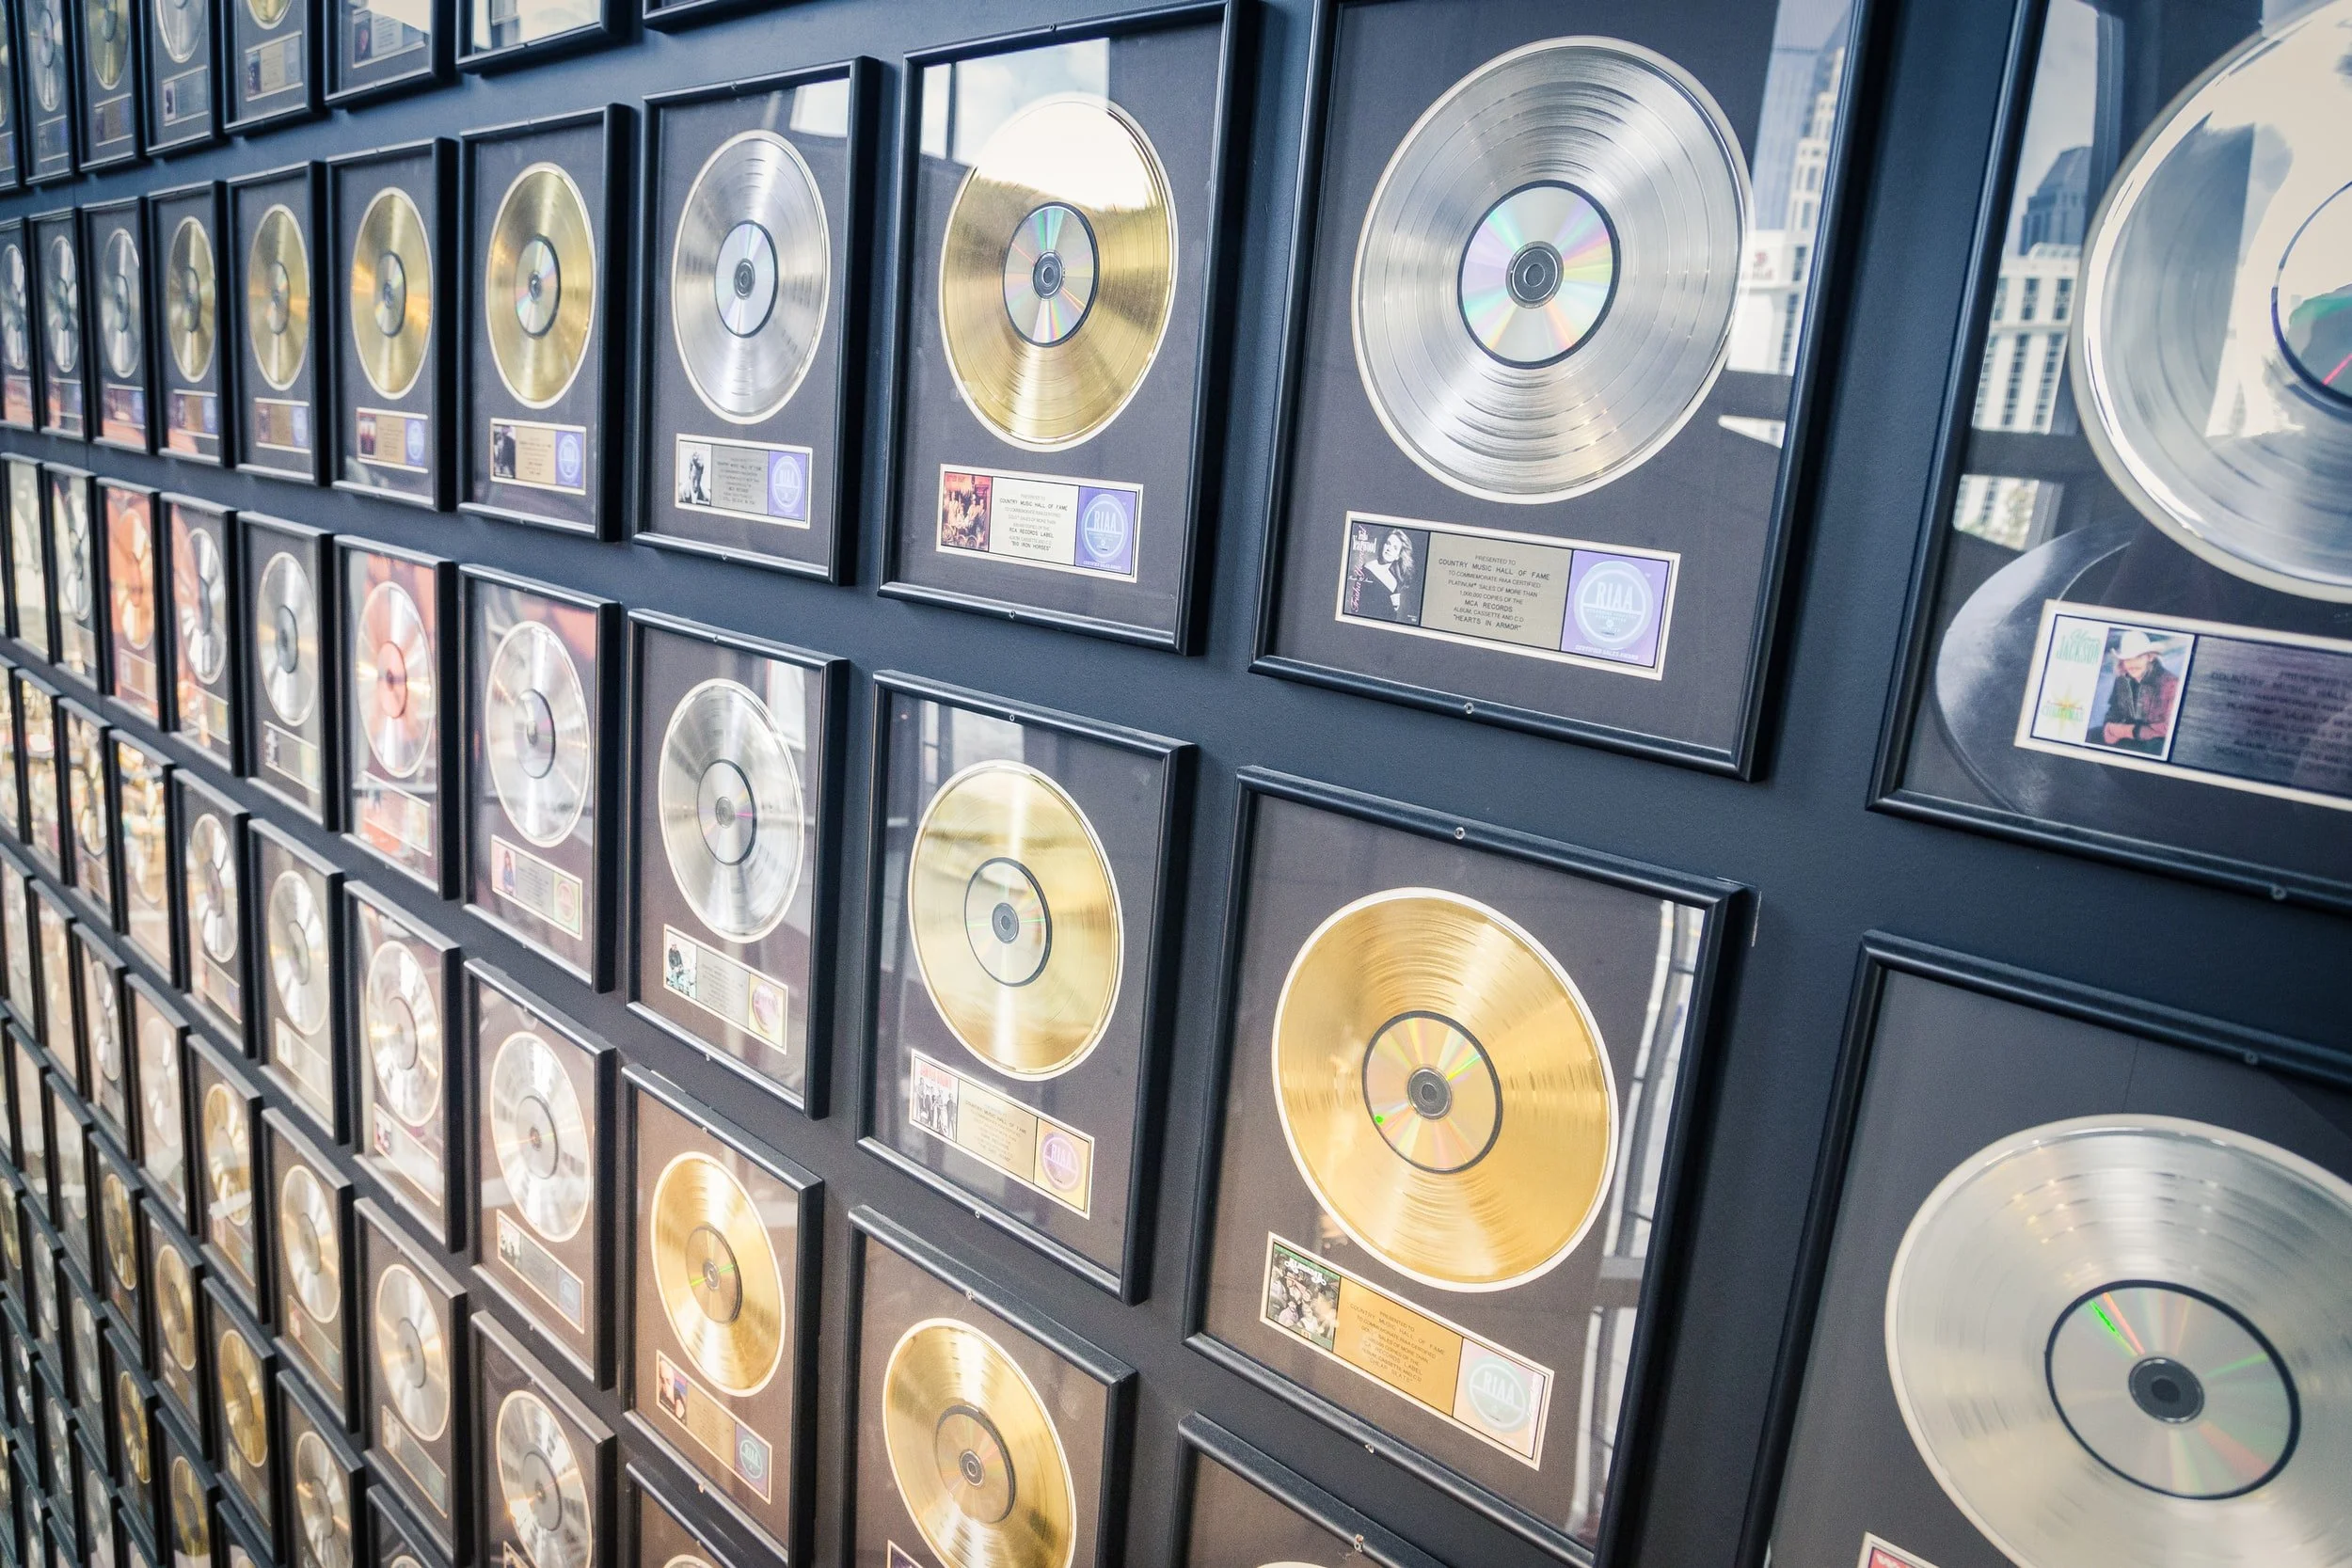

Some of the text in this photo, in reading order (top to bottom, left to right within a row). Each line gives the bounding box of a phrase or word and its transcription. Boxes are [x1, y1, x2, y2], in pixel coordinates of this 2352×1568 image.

[1475, 555, 1509, 564] PRESENTED
[1438, 558, 1468, 568] COUNTRY
[1472, 562, 1492, 572] MUSIC
[1496, 566, 1514, 576] HALL
[1532, 572, 1550, 580] FAME
[1456, 571, 1498, 582] COMMEMORATE
[1512, 579, 1541, 589] CERTIFIED
[1484, 594, 1502, 602] COPIES
[1596, 581, 1634, 611] RIAA
[1465, 599, 1513, 613] MCA RECORDS
[1473, 610, 1501, 619] CASSETTE
[1453, 614, 1482, 625] "HEARTS
[1496, 622, 1521, 632] ARMOR"
[1350, 1304, 1375, 1321] COUNTRY
[1378, 1318, 1395, 1331] MUSIC
[1400, 1328, 1413, 1340] HALL
[1419, 1338, 1425, 1346] OF
[1429, 1343, 1445, 1355] FAME
[1405, 1361, 1422, 1376] LABEL
[1483, 1370, 1515, 1405] RIAA
